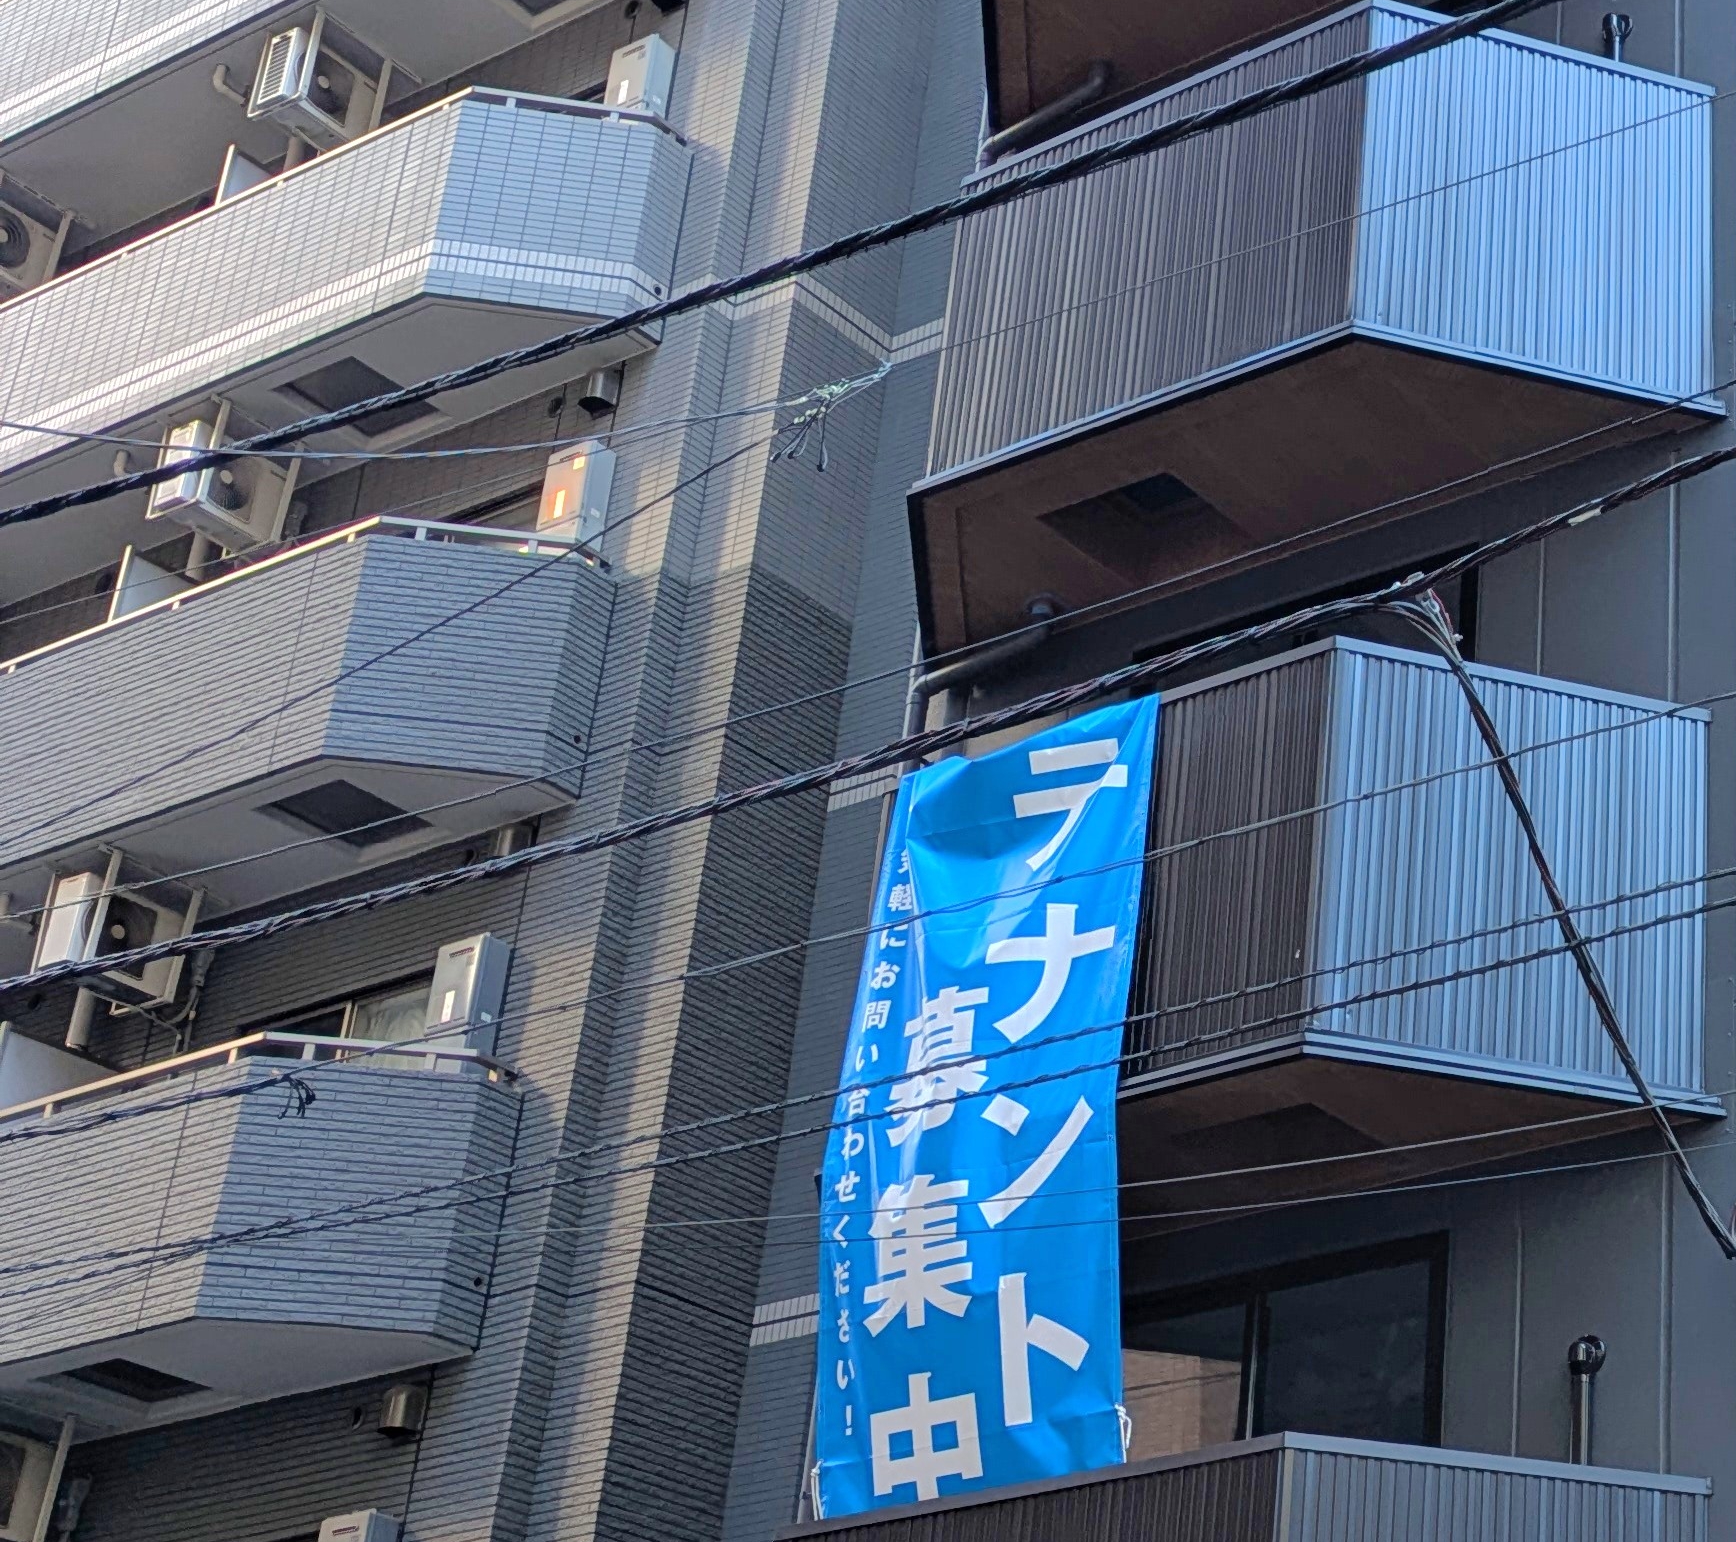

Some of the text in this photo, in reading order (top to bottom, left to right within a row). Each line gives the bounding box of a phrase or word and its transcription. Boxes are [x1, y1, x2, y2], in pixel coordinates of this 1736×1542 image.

[862, 984, 990, 1503] 募集中
[977, 737, 1129, 1427] テナント
